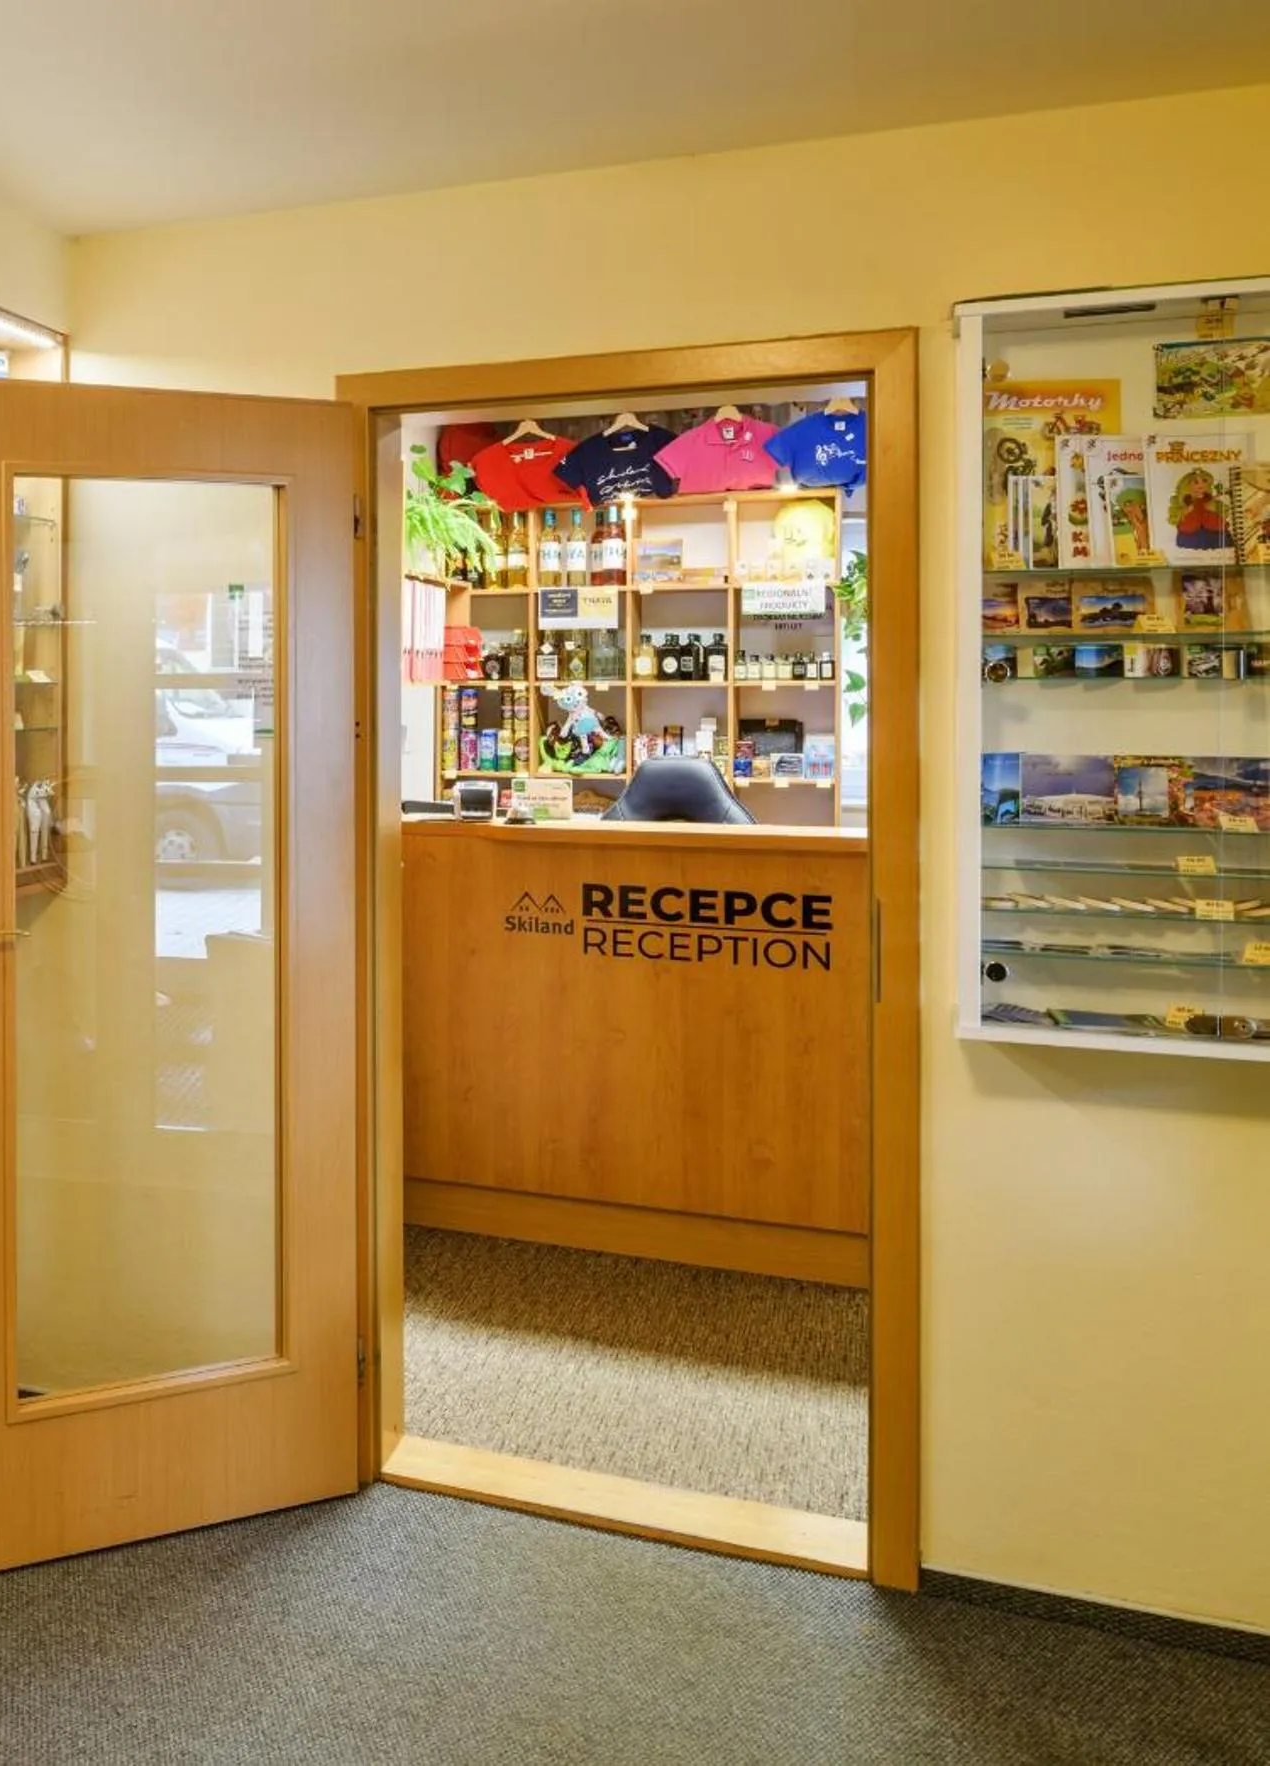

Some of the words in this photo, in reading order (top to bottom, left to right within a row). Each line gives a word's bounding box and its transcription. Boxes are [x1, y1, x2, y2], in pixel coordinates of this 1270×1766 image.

[986, 391, 1102, 412] Motorky
[1156, 450, 1242, 463] PRINCEZNY
[582, 883, 832, 931] RECEPCE
[504, 915, 575, 935] Skiland
[583, 927, 830, 971] RECEPTION
